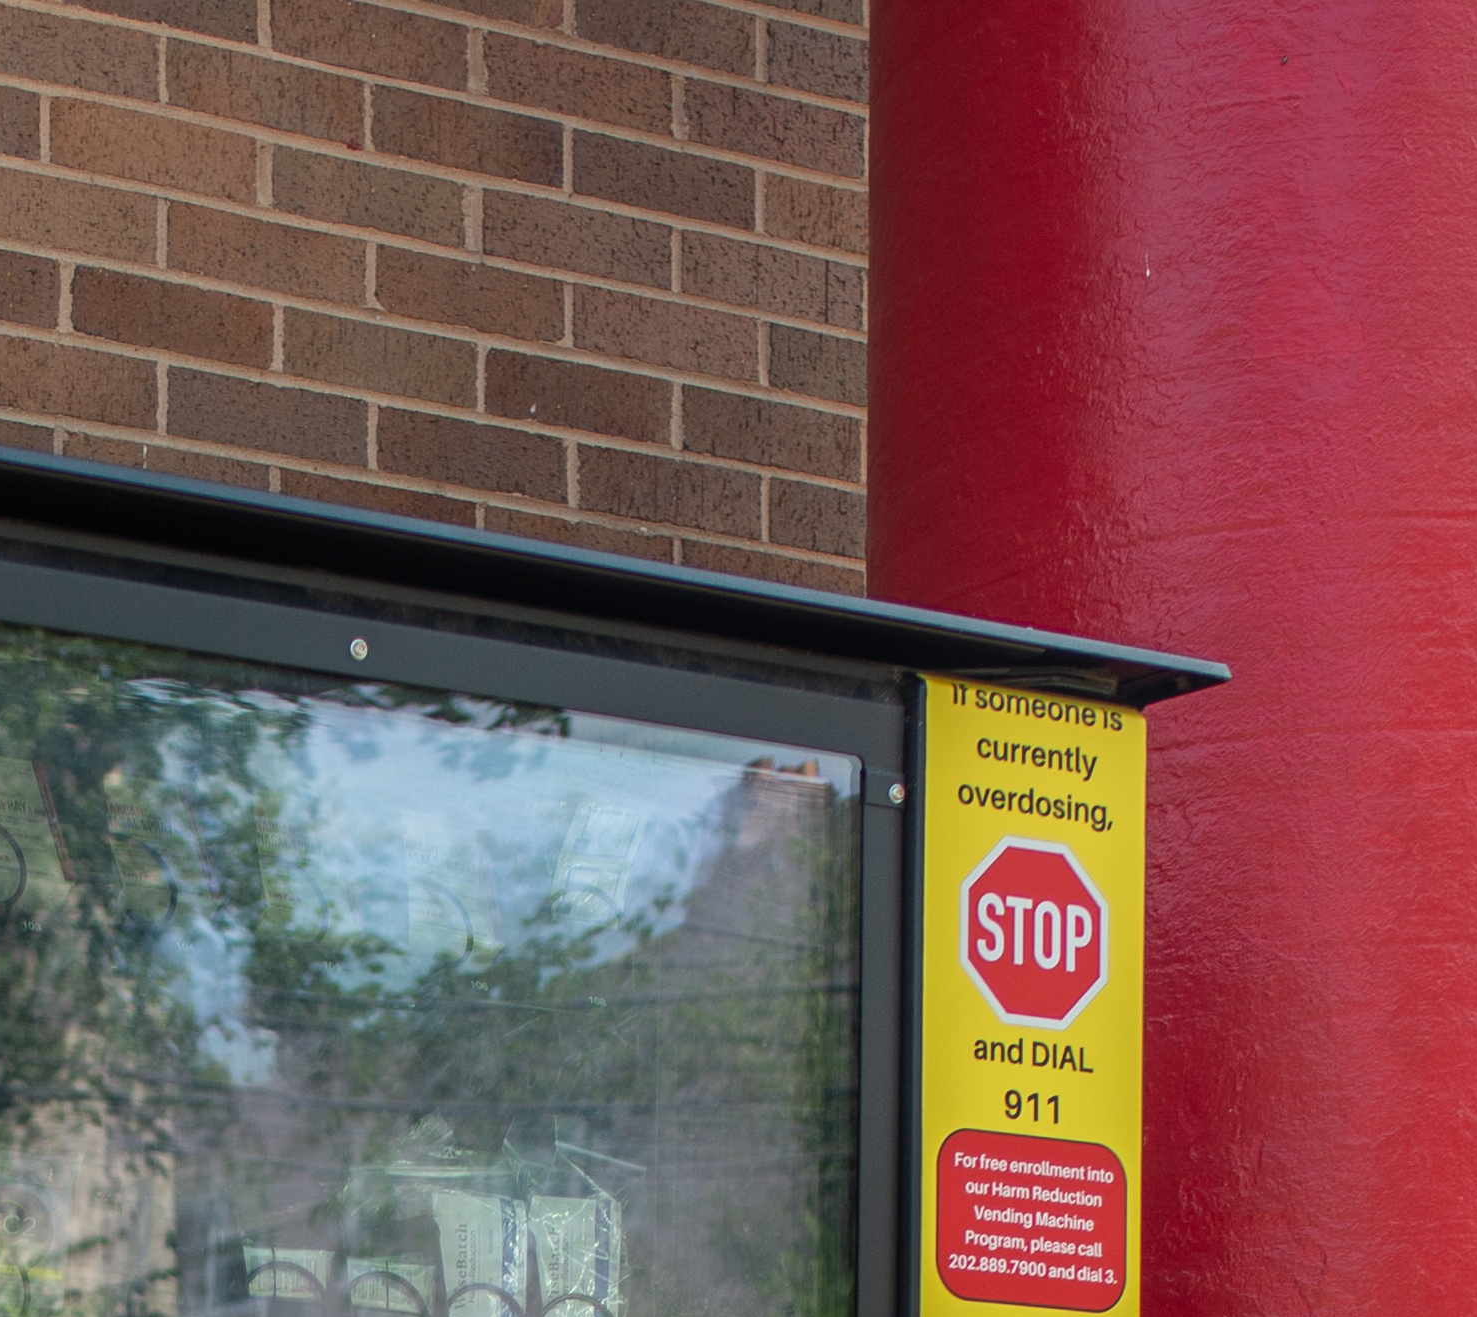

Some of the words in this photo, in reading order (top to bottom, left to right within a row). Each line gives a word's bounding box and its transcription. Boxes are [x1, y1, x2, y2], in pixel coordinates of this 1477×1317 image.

[952, 683, 969, 706] If
[975, 685, 1096, 727] someone
[1101, 708, 1123, 731] is
[976, 737, 1098, 782] currently
[957, 783, 1113, 832] overdosing,
[976, 892, 1093, 973] STOP
[973, 1038, 1024, 1065] and
[1032, 1041, 1094, 1073] DIAL
[1004, 1089, 1061, 1124] 911
[954, 1151, 978, 1169] For
[979, 1153, 1008, 1172] free
[1010, 1160, 1085, 1180] enrollment
[1087, 1166, 1114, 1184] into
[965, 1180, 990, 1195] our
[992, 1182, 1030, 1199] Harm
[1032, 1186, 1103, 1208] Reduction
[973, 1205, 1033, 1229] Vending
[1036, 1211, 1095, 1232] Machine
[964, 1230, 1027, 1252] Program,
[1030, 1236, 1076, 1256] please
[1077, 1242, 1103, 1258] call
[948, 1254, 1047, 1278] 202.889.7900
[1048, 1265, 1075, 1281] and
[1077, 1267, 1103, 1283] dial
[1105, 1270, 1118, 1285] 3.
